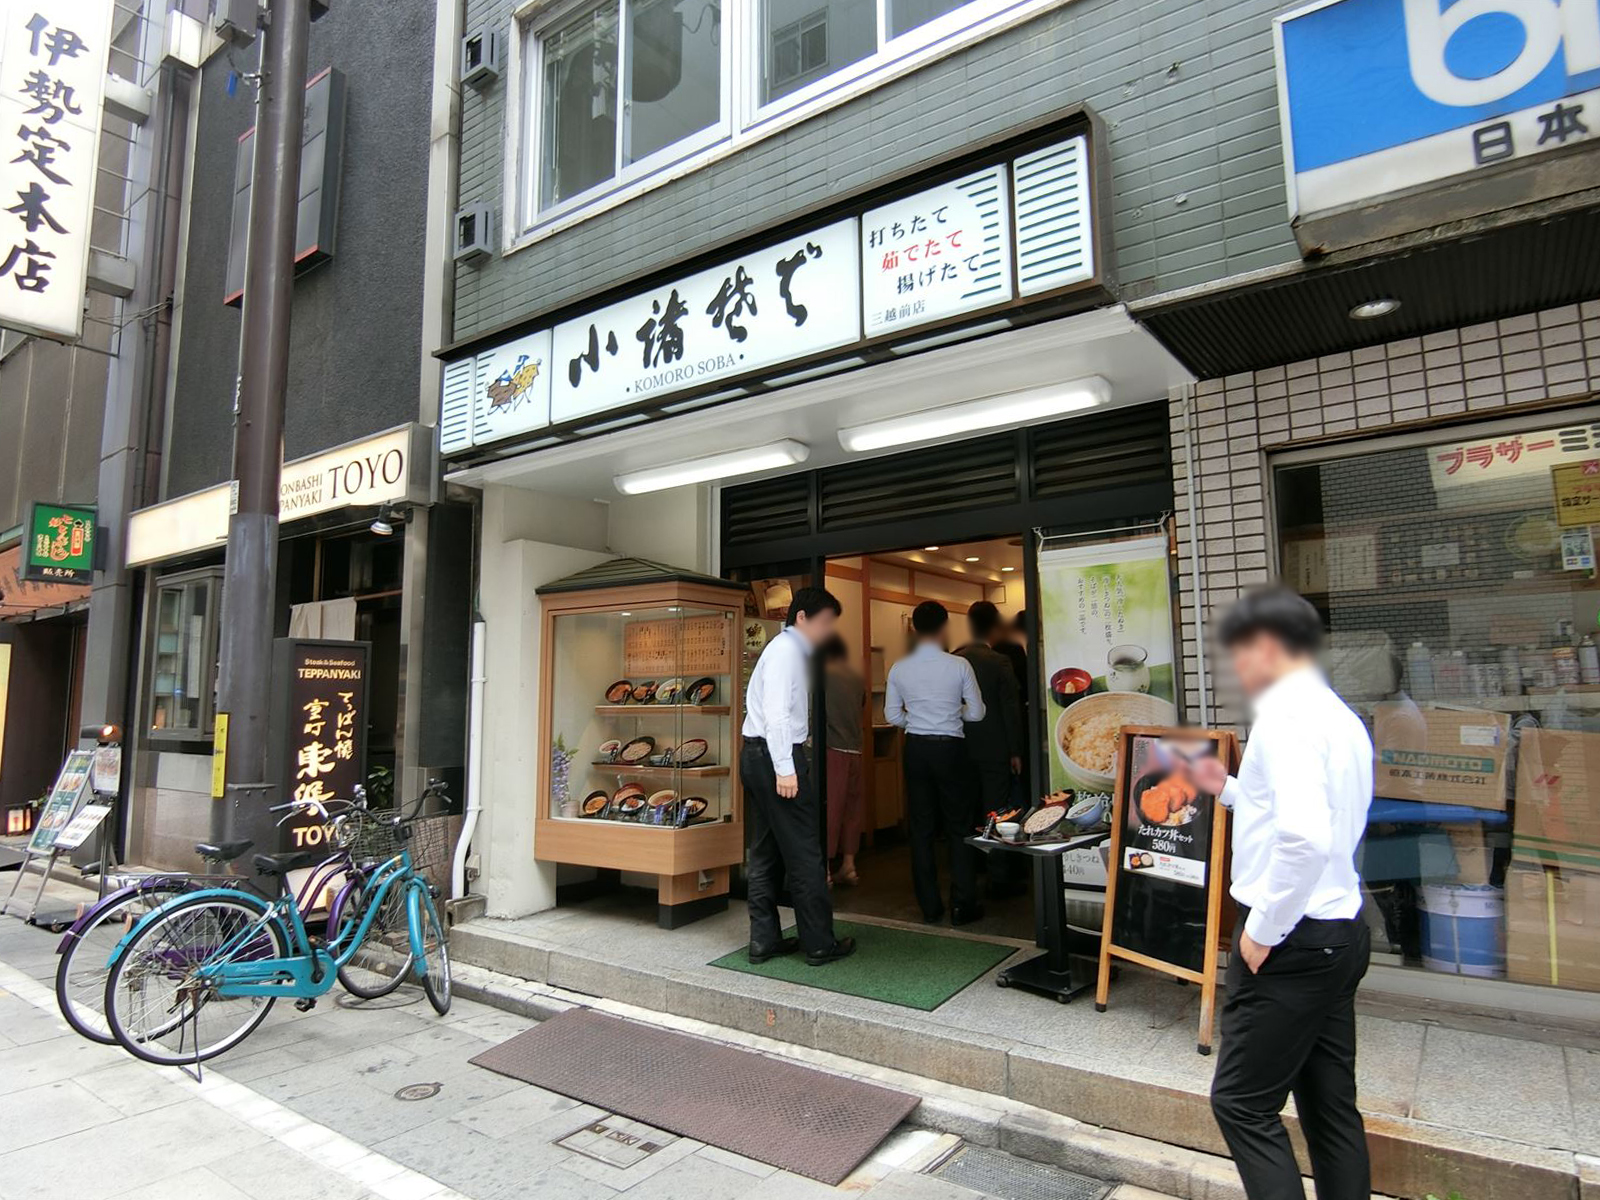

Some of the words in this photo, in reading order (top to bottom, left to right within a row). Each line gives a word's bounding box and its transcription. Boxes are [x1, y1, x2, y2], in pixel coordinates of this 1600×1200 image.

[0, 12, 90, 295] 伊勢定本店
[1472, 103, 1589, 165] 日本
[870, 206, 949, 249] 打ちたて
[881, 230, 962, 273] 茹でたて
[897, 254, 980, 295] 揚げたて
[871, 300, 926, 326] 三越前店
[634, 363, 694, 393] KOMORO
[699, 356, 736, 375] SOBA
[328, 449, 403, 499] TOYO
[297, 668, 361, 679] TEPPANYAKI
[292, 825, 341, 847] TOY
[1138, 824, 1194, 844] たれカツ丼セット
